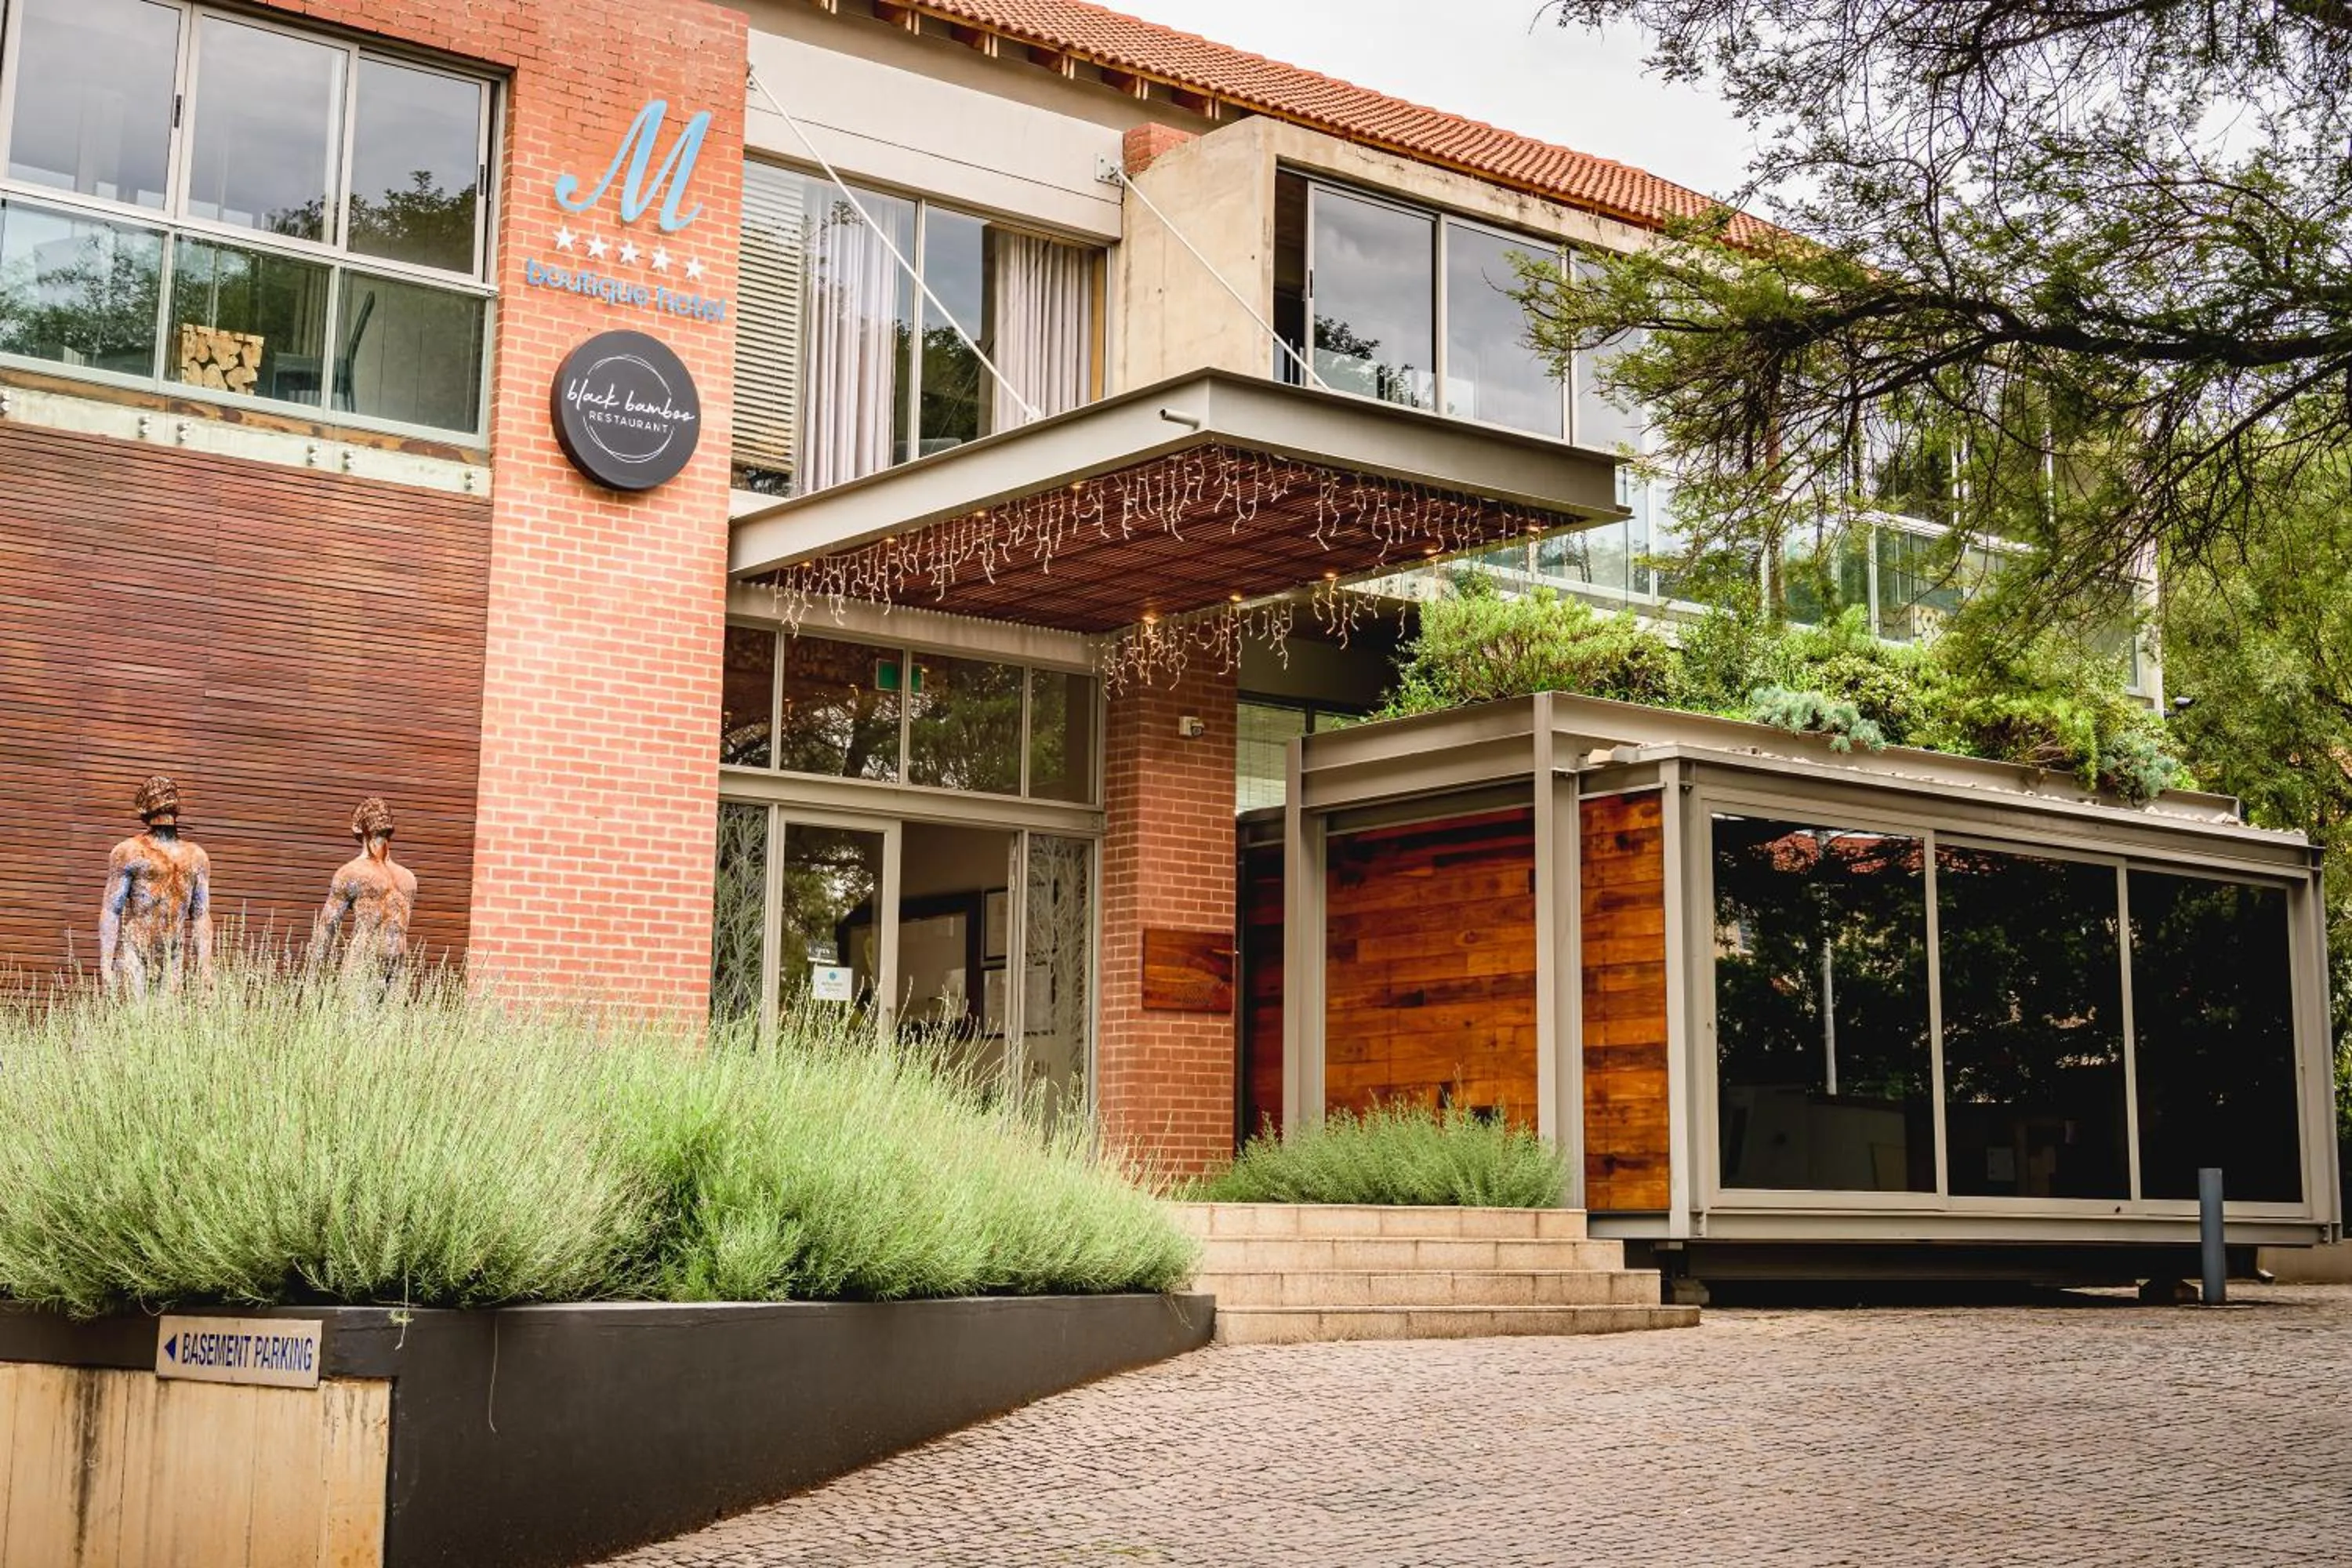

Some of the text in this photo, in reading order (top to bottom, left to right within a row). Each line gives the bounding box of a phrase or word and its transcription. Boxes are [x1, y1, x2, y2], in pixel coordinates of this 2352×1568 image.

[555, 99, 712, 231] M
[526, 257, 726, 321] boutique hotel
[567, 379, 695, 422] black bamboo
[588, 410, 669, 433] RESTAURANT
[181, 1332, 313, 1372] BASEMENT PARKING
